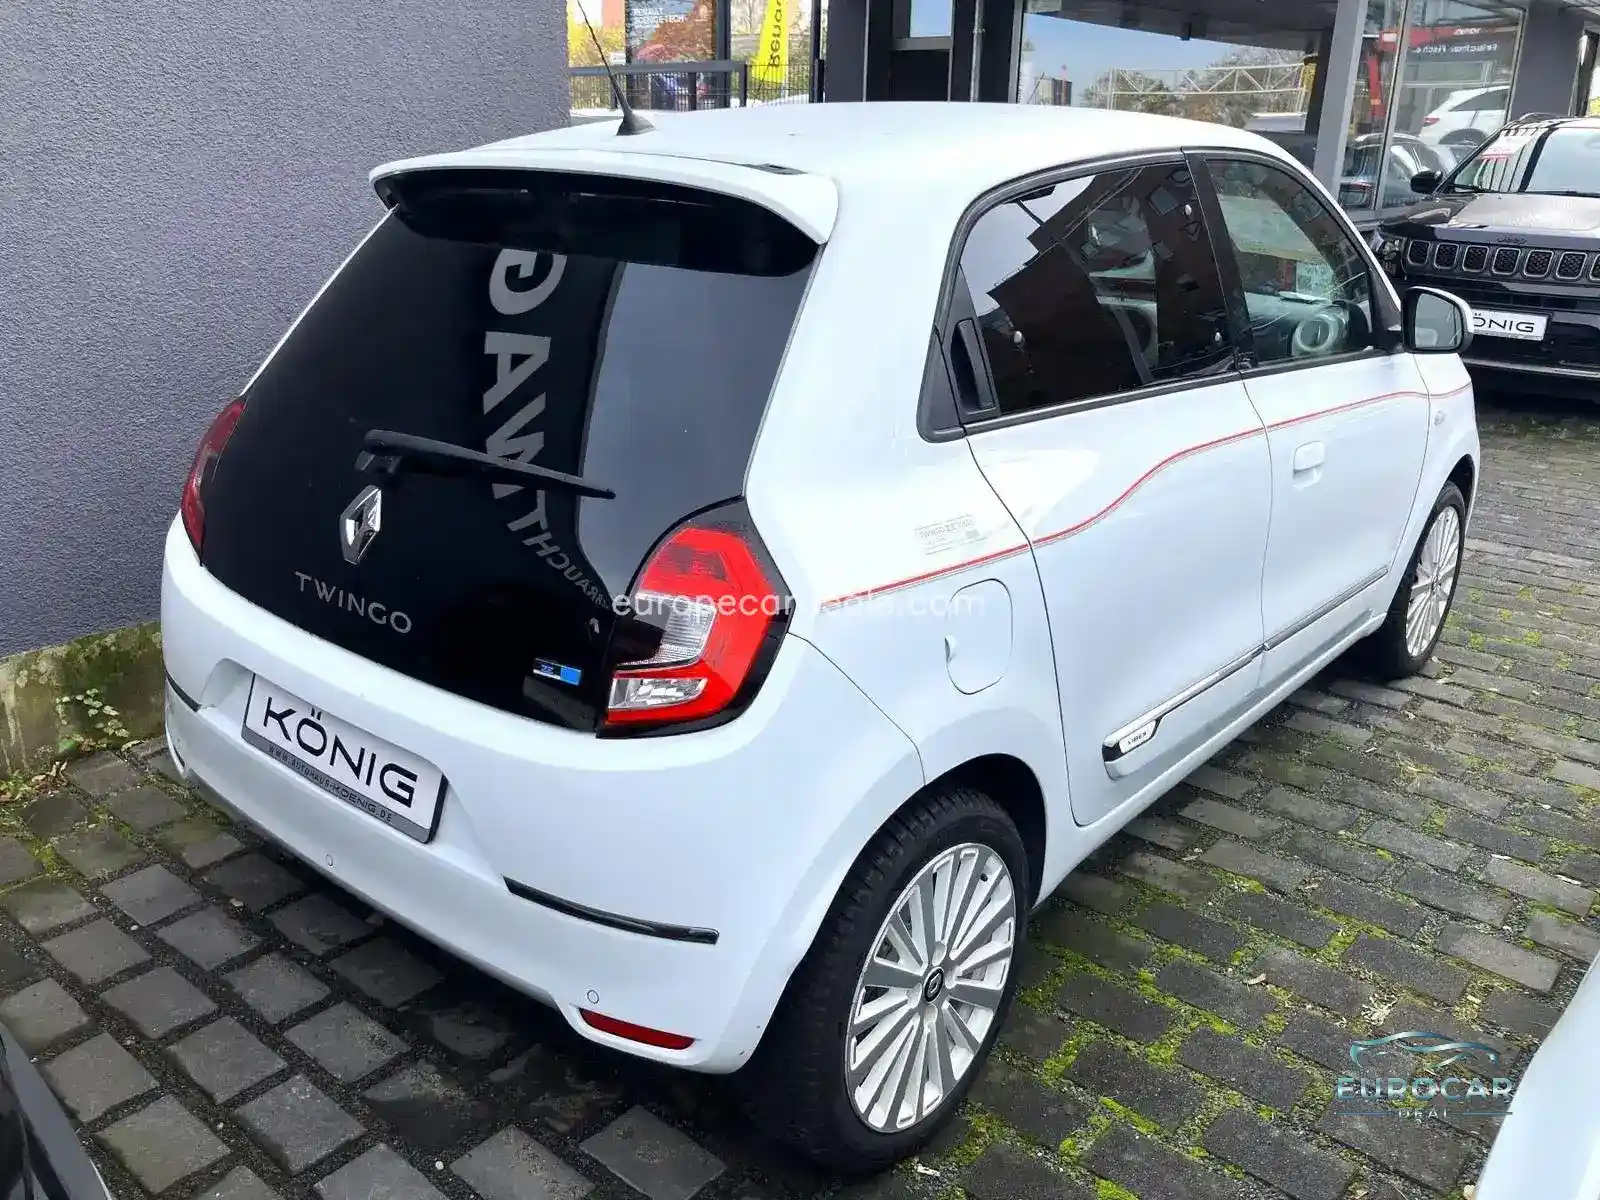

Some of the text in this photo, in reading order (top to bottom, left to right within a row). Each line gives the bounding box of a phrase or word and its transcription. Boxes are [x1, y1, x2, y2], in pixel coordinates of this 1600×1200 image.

[1473, 312, 1535, 333] ÖNIG
[294, 570, 412, 634] TWINGO
[263, 696, 418, 808] KÖNIG
